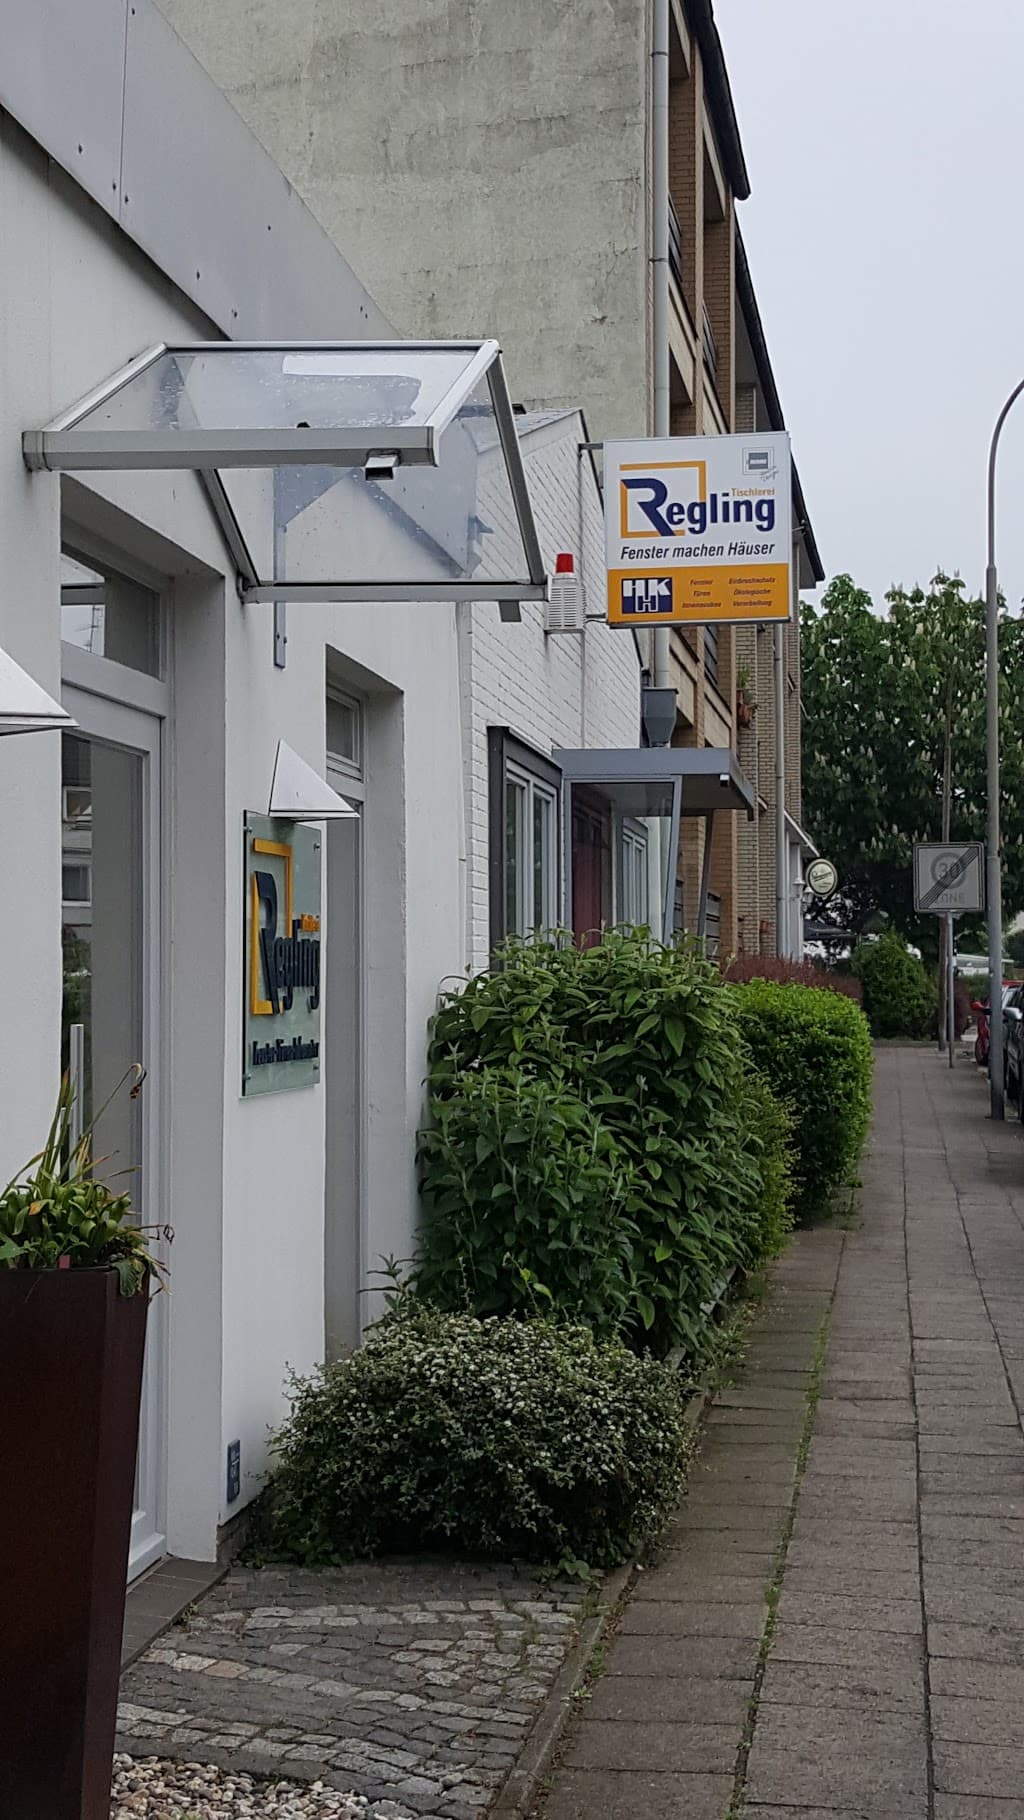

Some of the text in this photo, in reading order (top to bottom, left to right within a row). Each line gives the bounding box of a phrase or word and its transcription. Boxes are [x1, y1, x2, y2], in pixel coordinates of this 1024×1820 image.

[731, 487, 775, 497] Tischlerei
[620, 478, 775, 537] Regling
[621, 541, 776, 560] Fenster machen Häuser
[938, 862, 961, 879] 30
